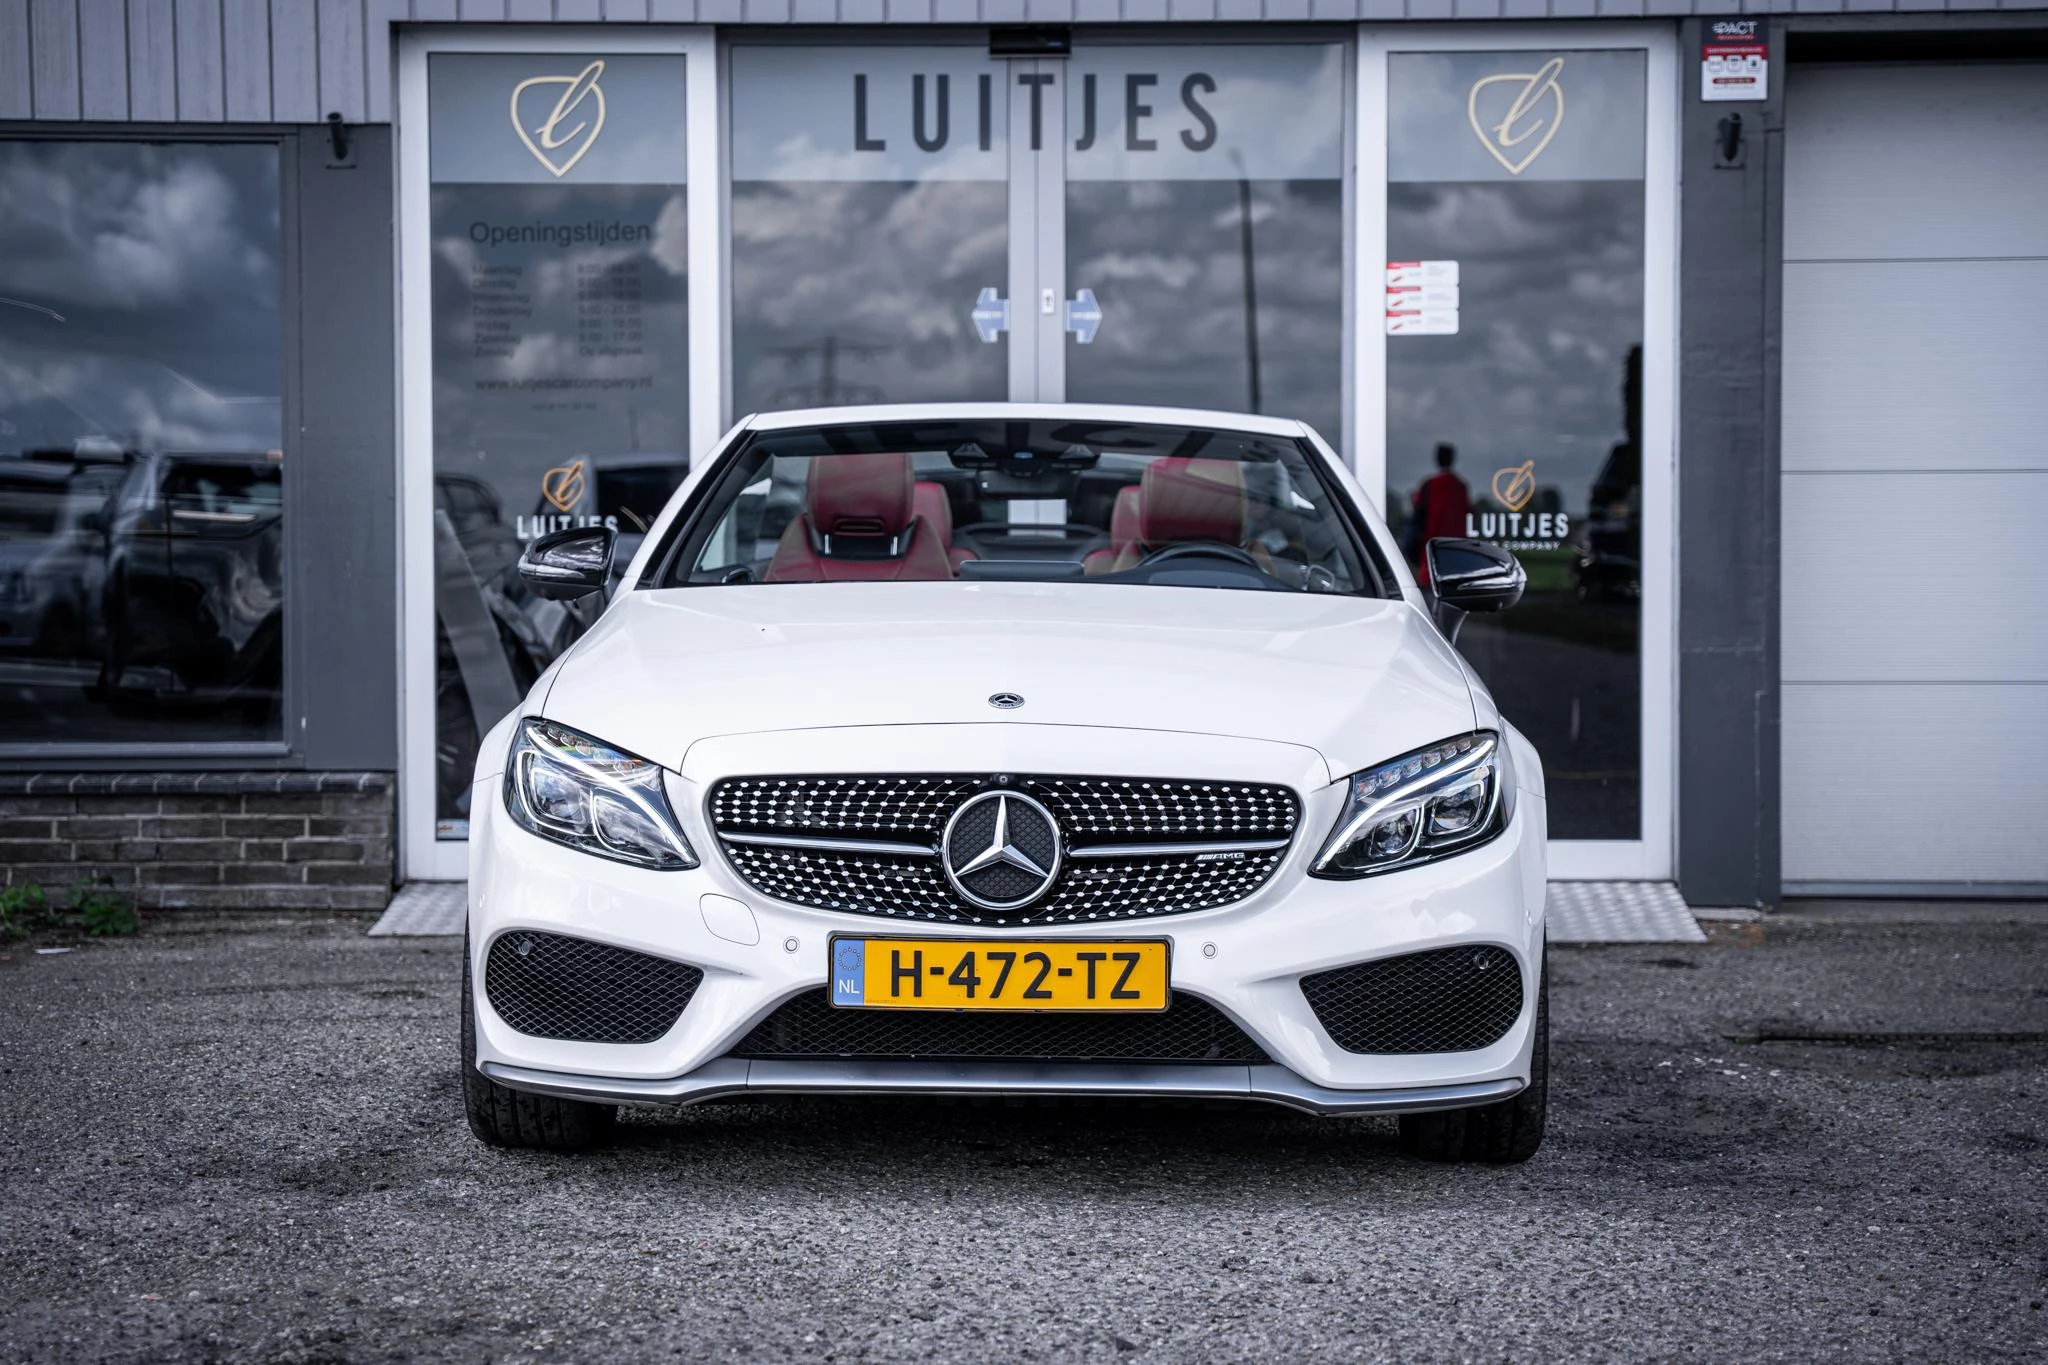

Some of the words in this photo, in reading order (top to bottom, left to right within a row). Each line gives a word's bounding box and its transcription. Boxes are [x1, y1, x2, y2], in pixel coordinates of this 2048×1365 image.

[853, 72, 1218, 152] LUITJES
[470, 221, 650, 247] Openingstijden
[1466, 512, 1569, 538] LUITJES
[1211, 852, 1245, 860] AMG
[839, 979, 860, 994] NL
[890, 950, 1141, 999] H-472-TZ
